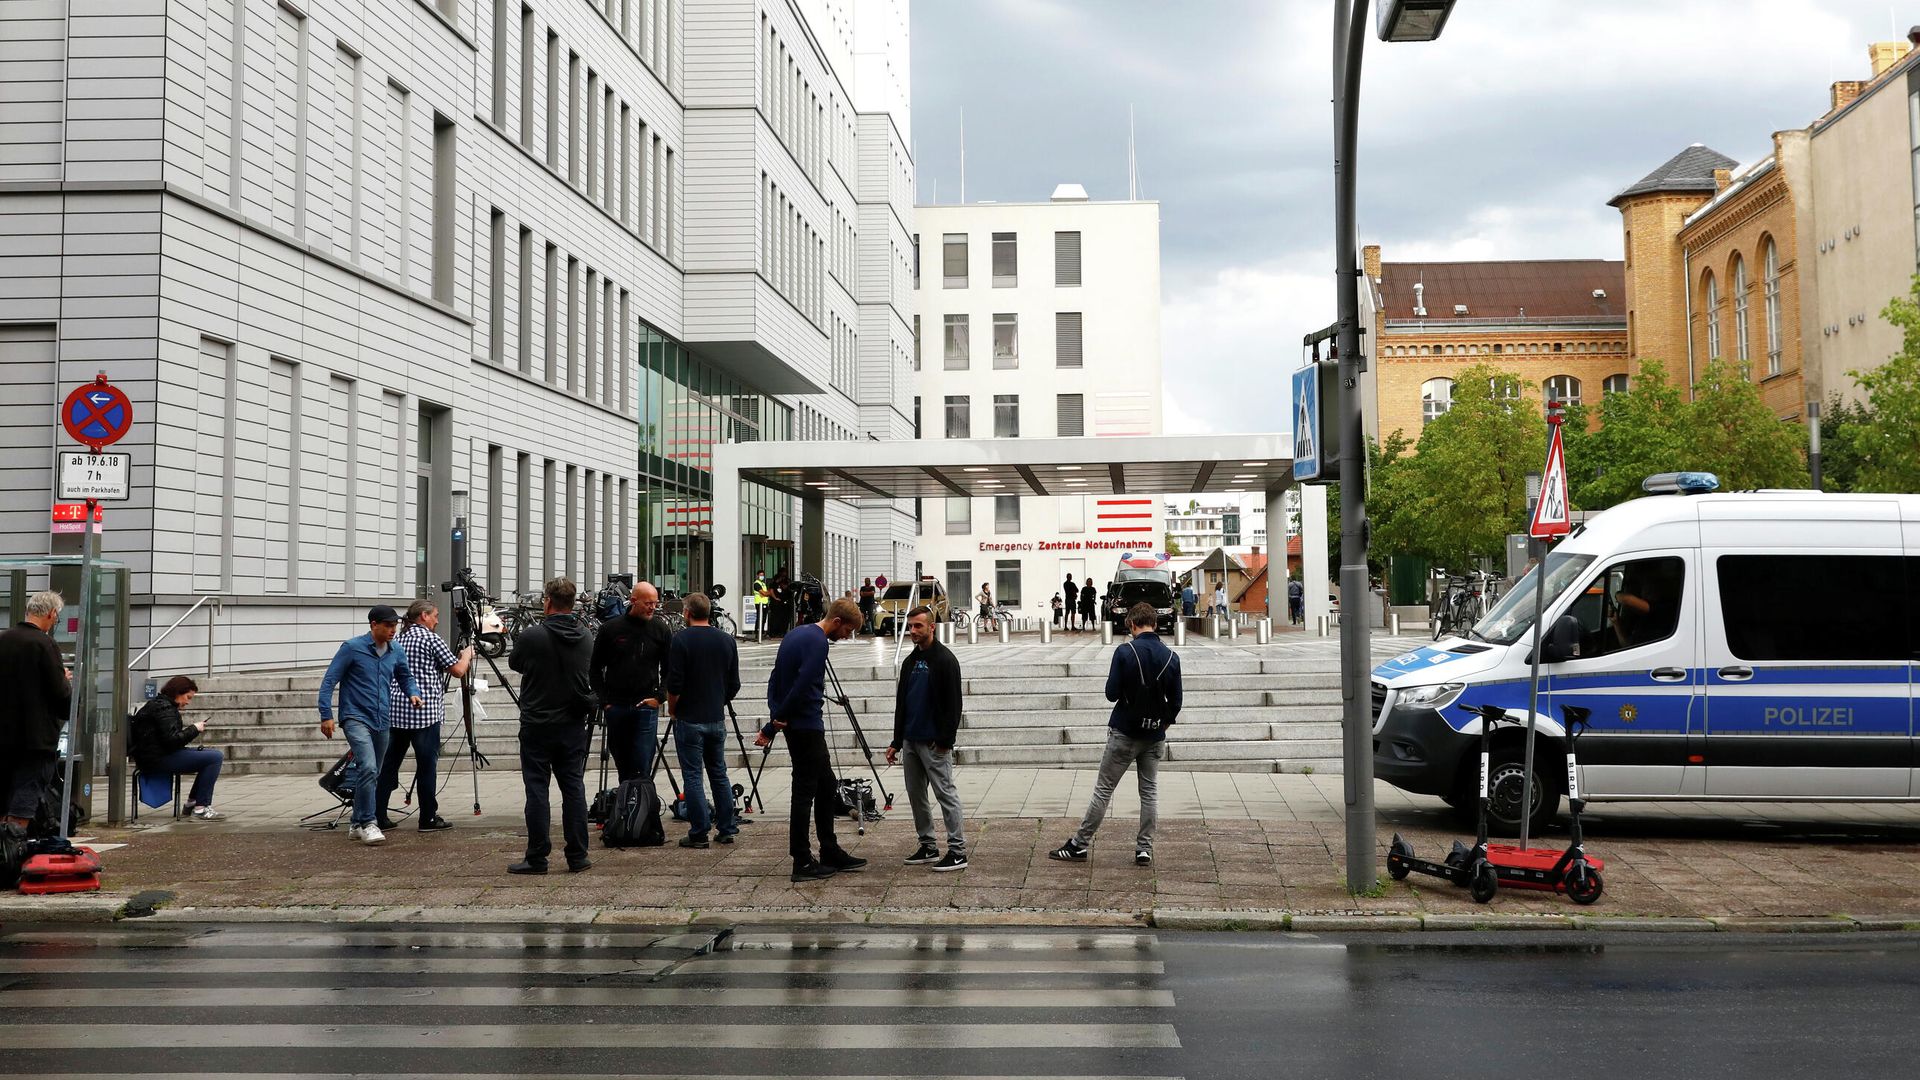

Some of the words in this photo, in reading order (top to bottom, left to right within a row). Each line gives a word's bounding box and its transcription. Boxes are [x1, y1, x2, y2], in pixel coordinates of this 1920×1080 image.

[71, 455, 83, 465] ab
[87, 455, 119, 466] 19.6.18
[87, 470, 93, 480] 7
[96, 470, 102, 480] h
[979, 542, 1034, 552] Emergency
[1038, 541, 1081, 550] Zentrale
[1085, 540, 1153, 549] Notaufnahme
[1764, 707, 1853, 726] POLIZEI
[1568, 762, 1576, 790] BIRD
